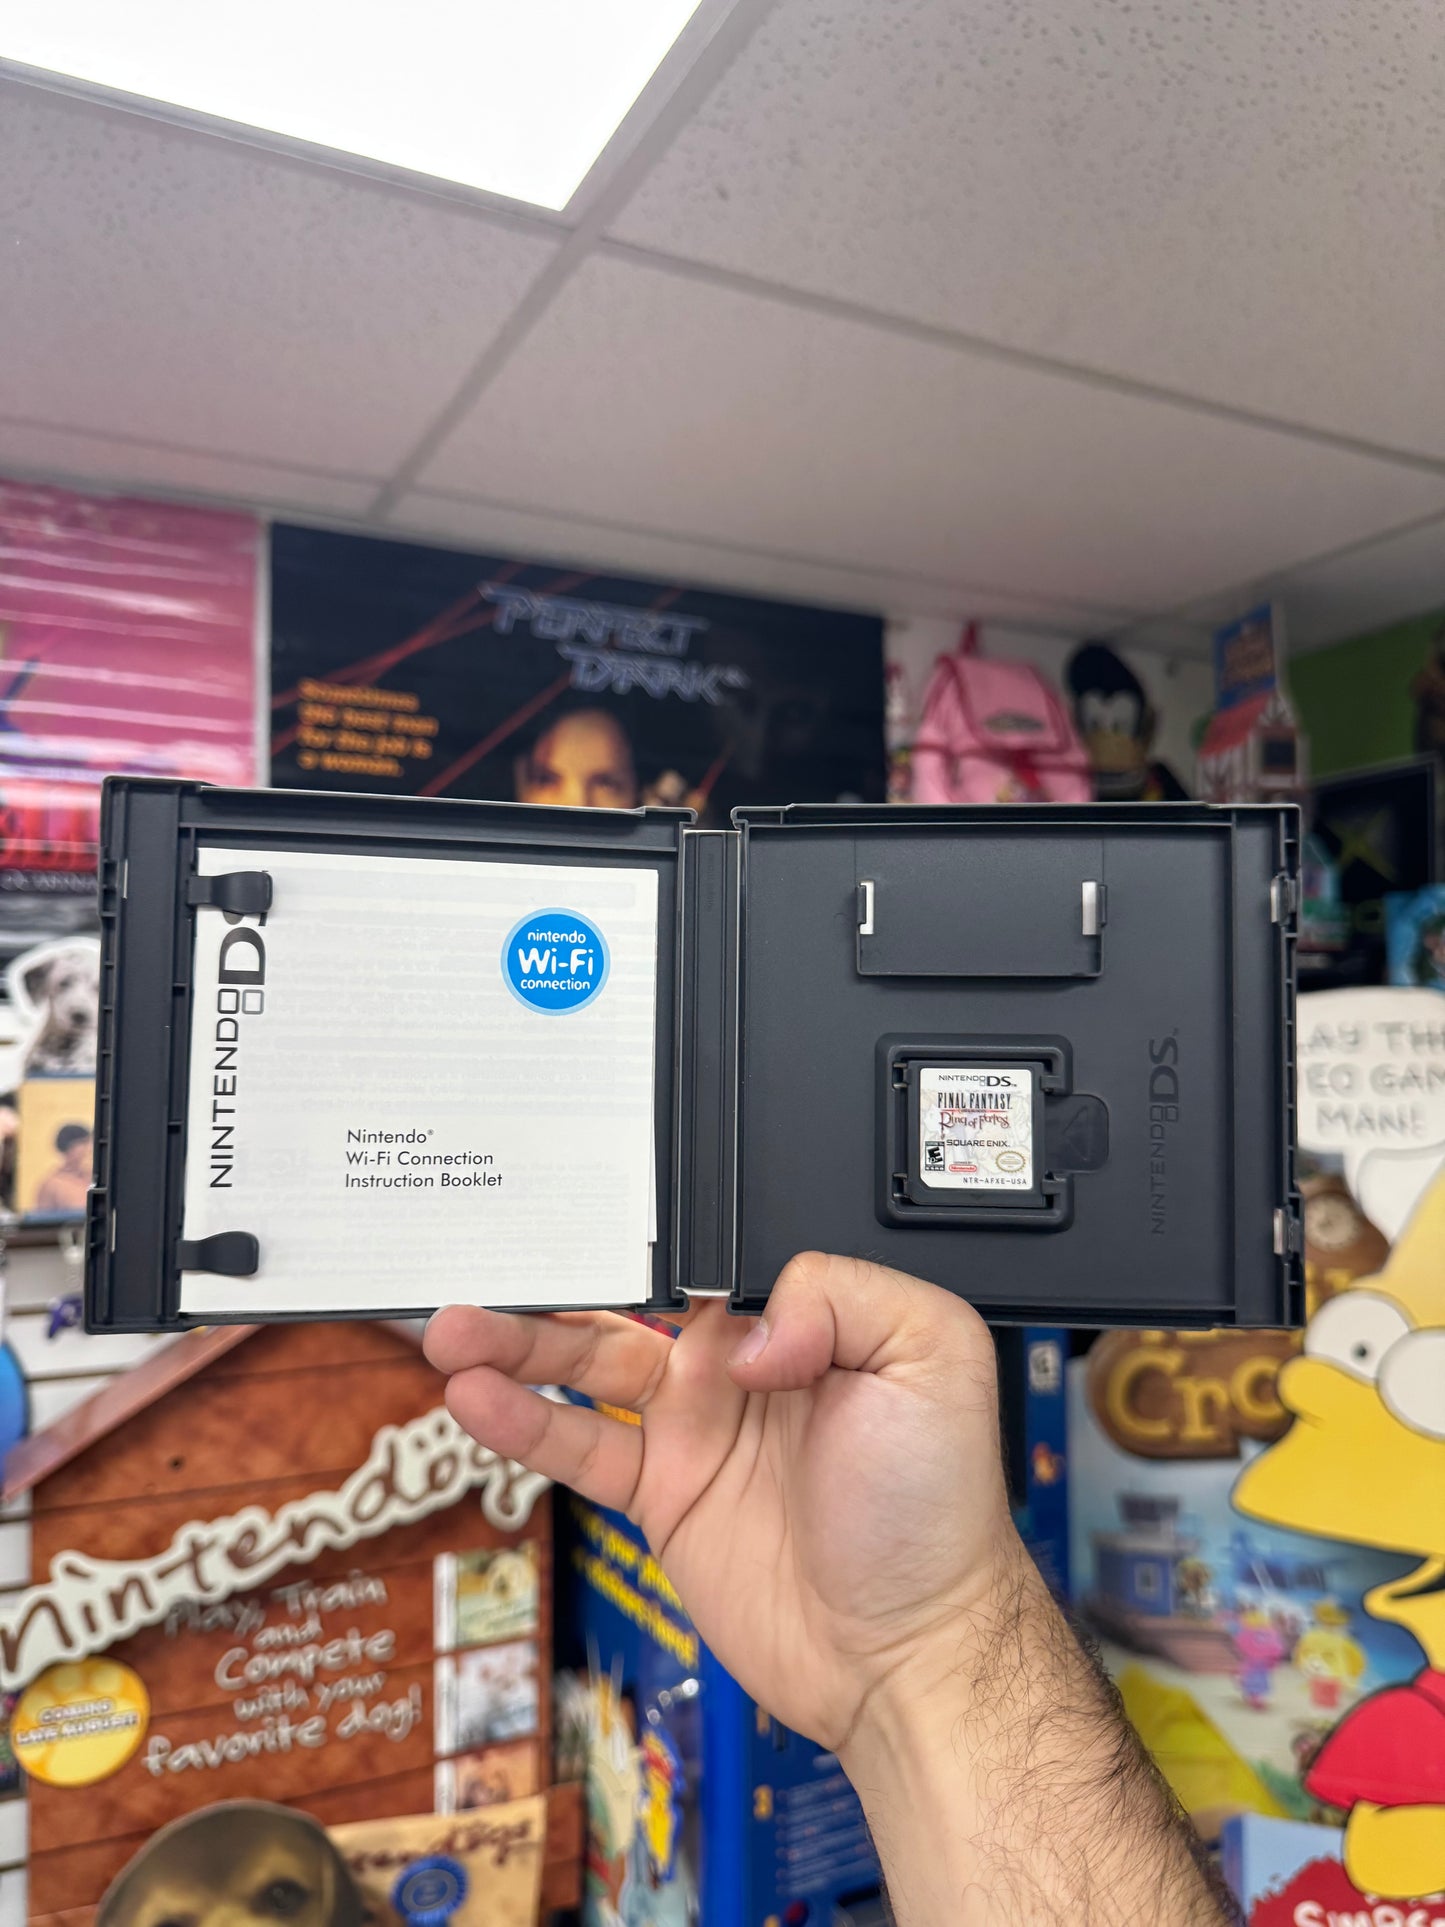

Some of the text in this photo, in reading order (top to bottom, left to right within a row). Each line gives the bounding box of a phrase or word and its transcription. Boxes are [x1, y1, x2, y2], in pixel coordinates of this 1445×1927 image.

[527, 929, 586, 943] nintendo
[518, 948, 593, 975] Wi-Fi
[521, 978, 590, 990] connection
[210, 988, 252, 1187] NINTENDO
[938, 1092, 1012, 1110] FINAL FANTASY
[946, 1139, 985, 1147] SQUARE
[346, 1151, 493, 1165] Wi-Fi Connection
[1150, 1105, 1171, 1234] NINTENDO
[345, 1172, 502, 1188] Instruction Booklet
[963, 1177, 1027, 1185] NTR-AFXE-USA
[271, 1569, 388, 1617] Train
[252, 1611, 323, 1650] and
[214, 1627, 396, 1690] Compete
[233, 1671, 386, 1721] with your
[141, 1682, 422, 1776] favorite dog!
